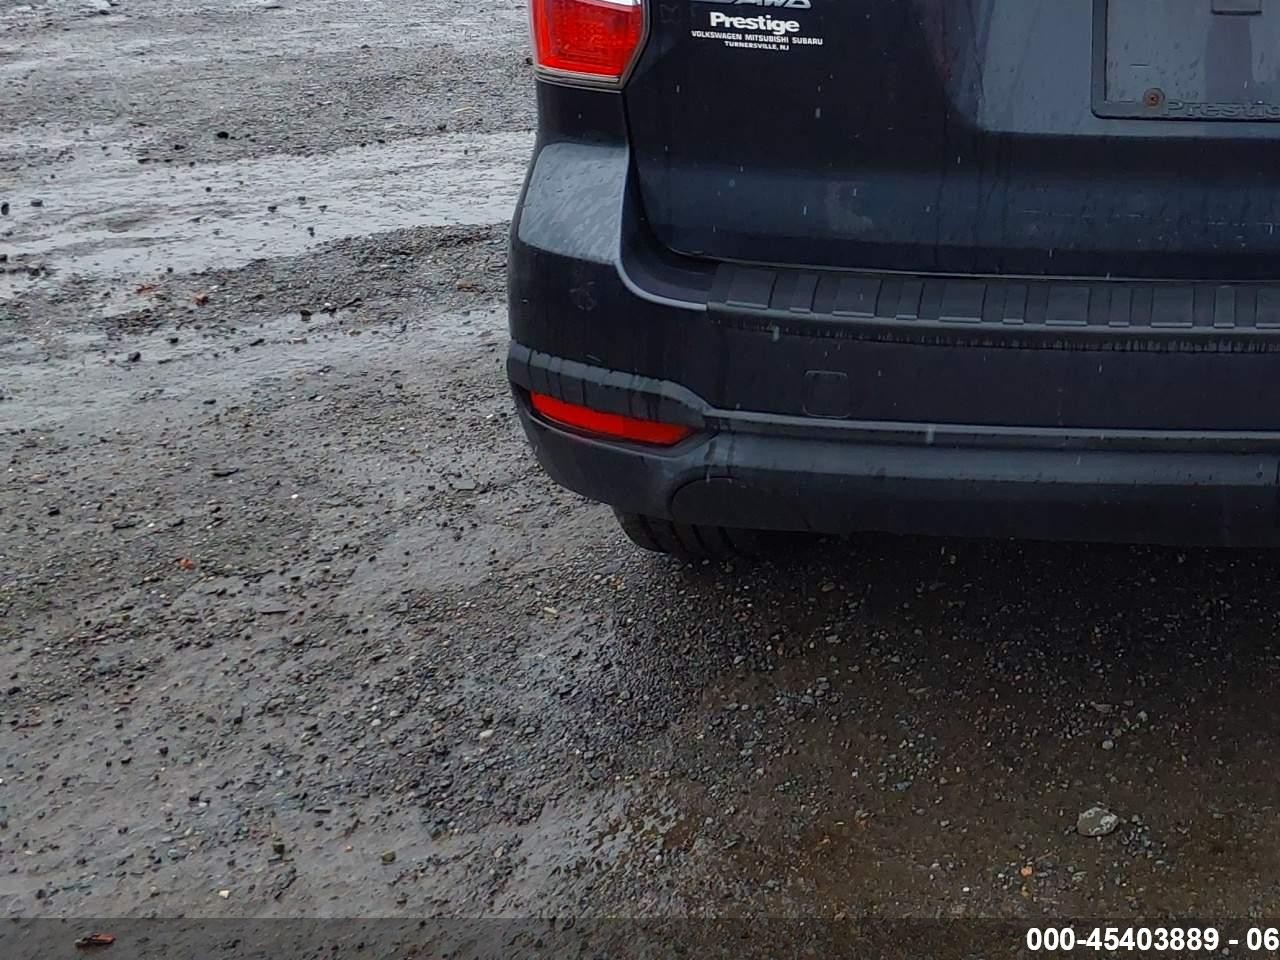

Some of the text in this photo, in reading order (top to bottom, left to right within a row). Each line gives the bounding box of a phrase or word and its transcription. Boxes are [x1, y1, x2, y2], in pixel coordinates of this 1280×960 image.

[710, 11, 800, 35] Prestige
[692, 30, 823, 45] VOLKSWAGEN MITSUBISHI SUBARU
[725, 40, 779, 50] TURNERSVILLE,
